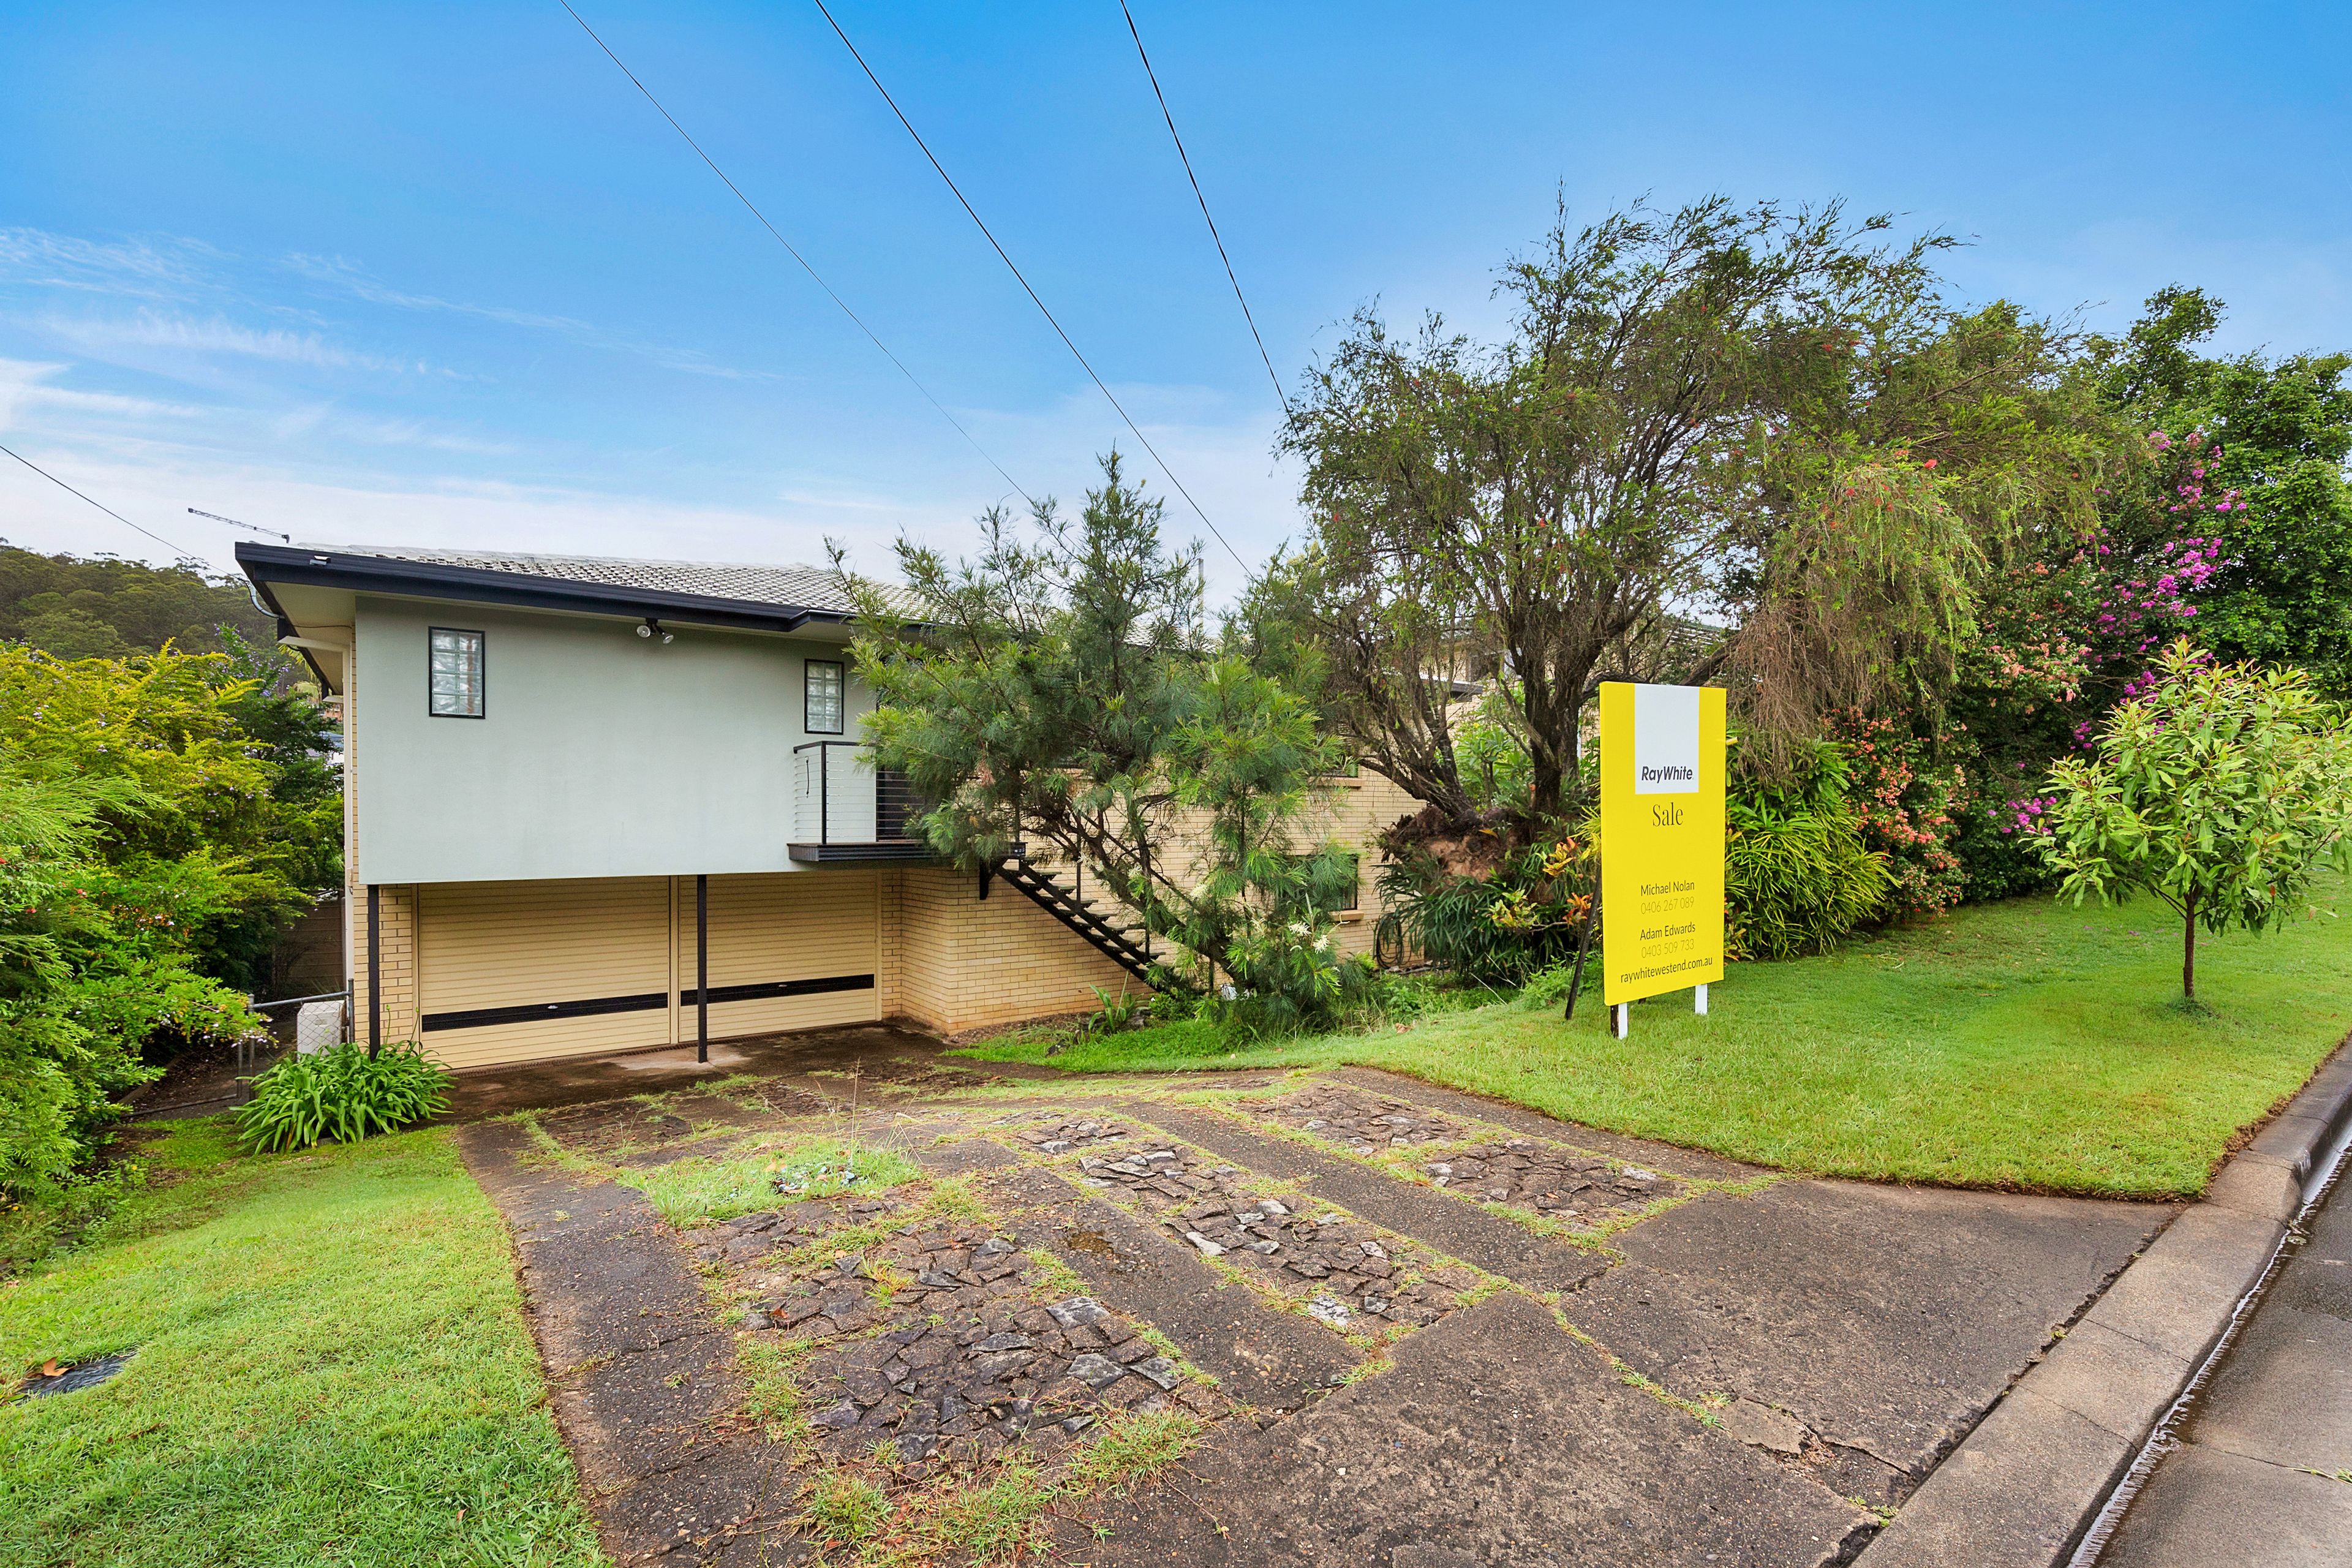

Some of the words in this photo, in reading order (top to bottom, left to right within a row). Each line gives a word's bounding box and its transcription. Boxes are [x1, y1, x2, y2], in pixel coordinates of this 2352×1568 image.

[1653, 802, 1683, 827] Sale
[1641, 882, 1671, 896] Michael
[1673, 880, 1695, 892] Nolan
[1640, 901, 1661, 914] 0406
[1664, 899, 1678, 911] 267
[1680, 897, 1695, 909] 089
[1640, 928, 1662, 941] Adam
[1665, 922, 1695, 937] Edwards
[1641, 944, 1662, 959] 0403
[1664, 941, 1678, 955] 509
[1681, 938, 1695, 951] 733
[1621, 957, 1713, 984] raywhitewestend.com.au
